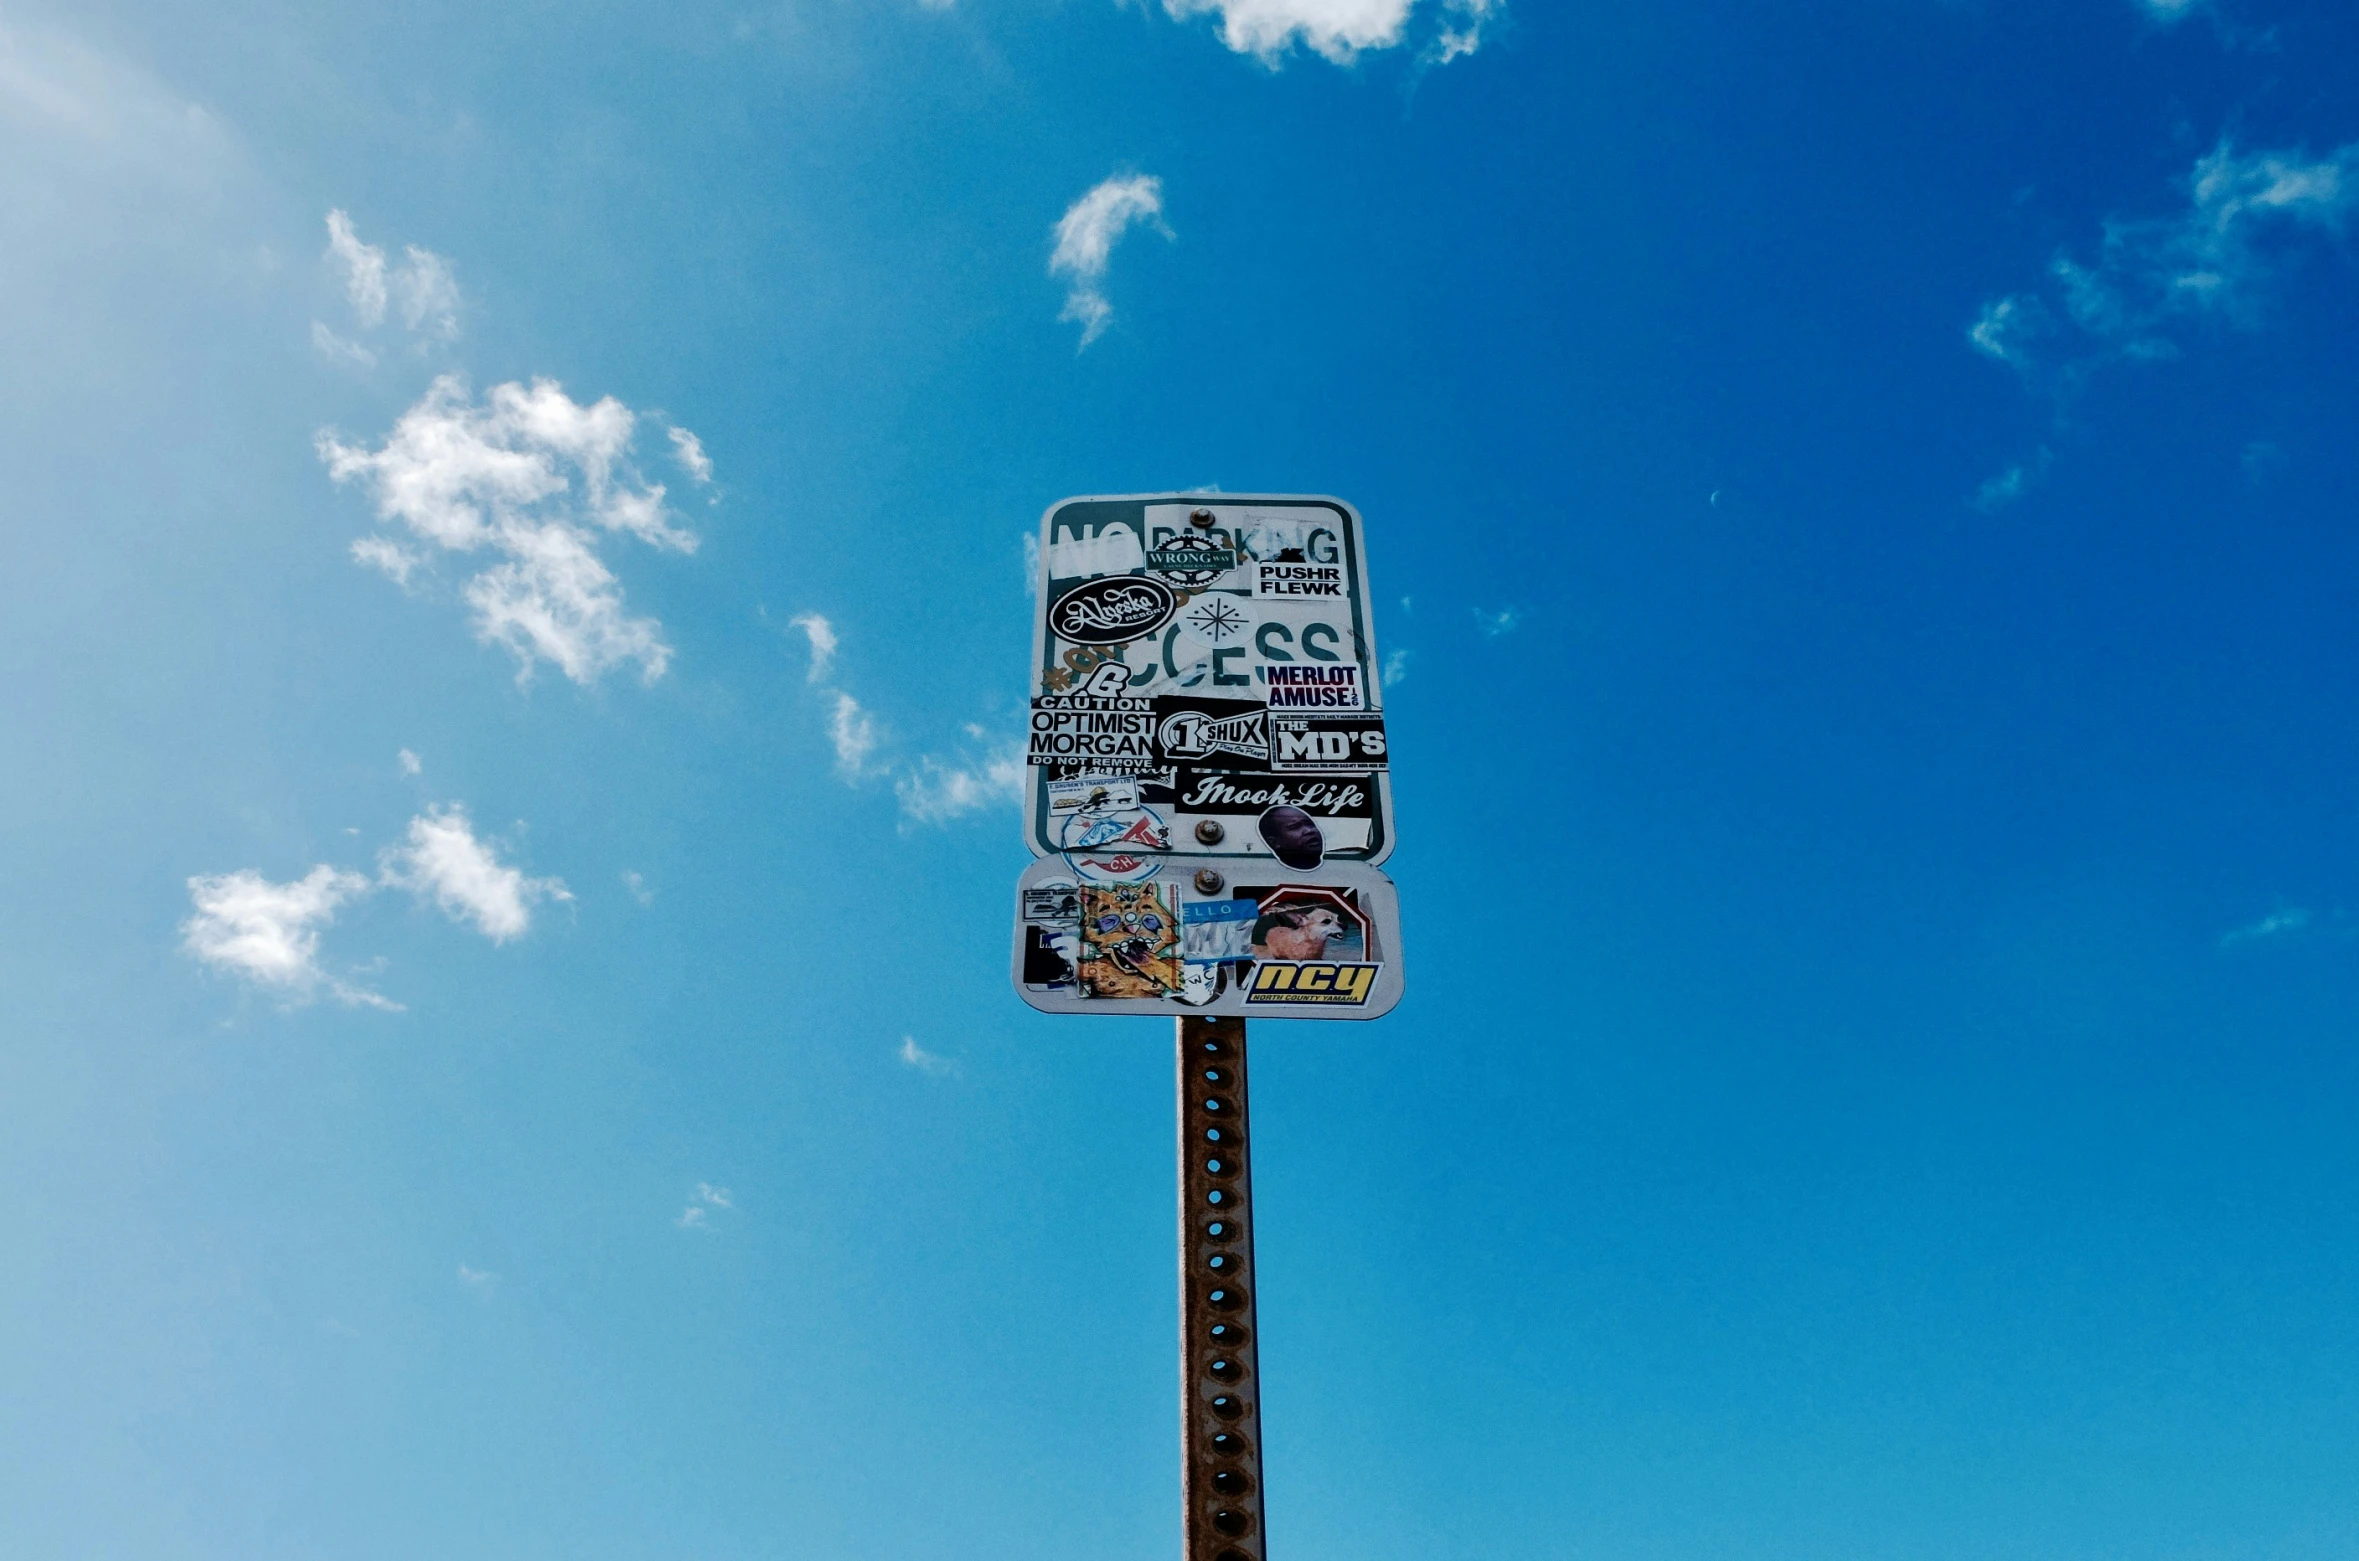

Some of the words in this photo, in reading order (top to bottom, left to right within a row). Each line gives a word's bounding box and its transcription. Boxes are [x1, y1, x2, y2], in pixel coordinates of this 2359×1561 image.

[1150, 552, 1211, 563] WRONG
[1260, 566, 1340, 580] PUSHR
[1261, 581, 1341, 595] FLEWK
[1062, 585, 1161, 633] Alyeska
[1124, 606, 1167, 621] RESORT
[1267, 666, 1357, 685] MERLOT
[1040, 697, 1151, 711] CAUTION
[1269, 687, 1350, 706] AMUSE
[1032, 711, 1156, 735] OPTIMIST
[1207, 718, 1262, 745] SHUX
[1277, 721, 1309, 731] THE
[1030, 733, 1154, 756] MORGAN
[1278, 731, 1386, 760] MD'S
[1032, 756, 1053, 765] DO
[1057, 757, 1088, 766] NOT
[1092, 759, 1153, 768] REMOVE
[1290, 783, 1365, 815] Life
[1183, 905, 1231, 917] ELLO
